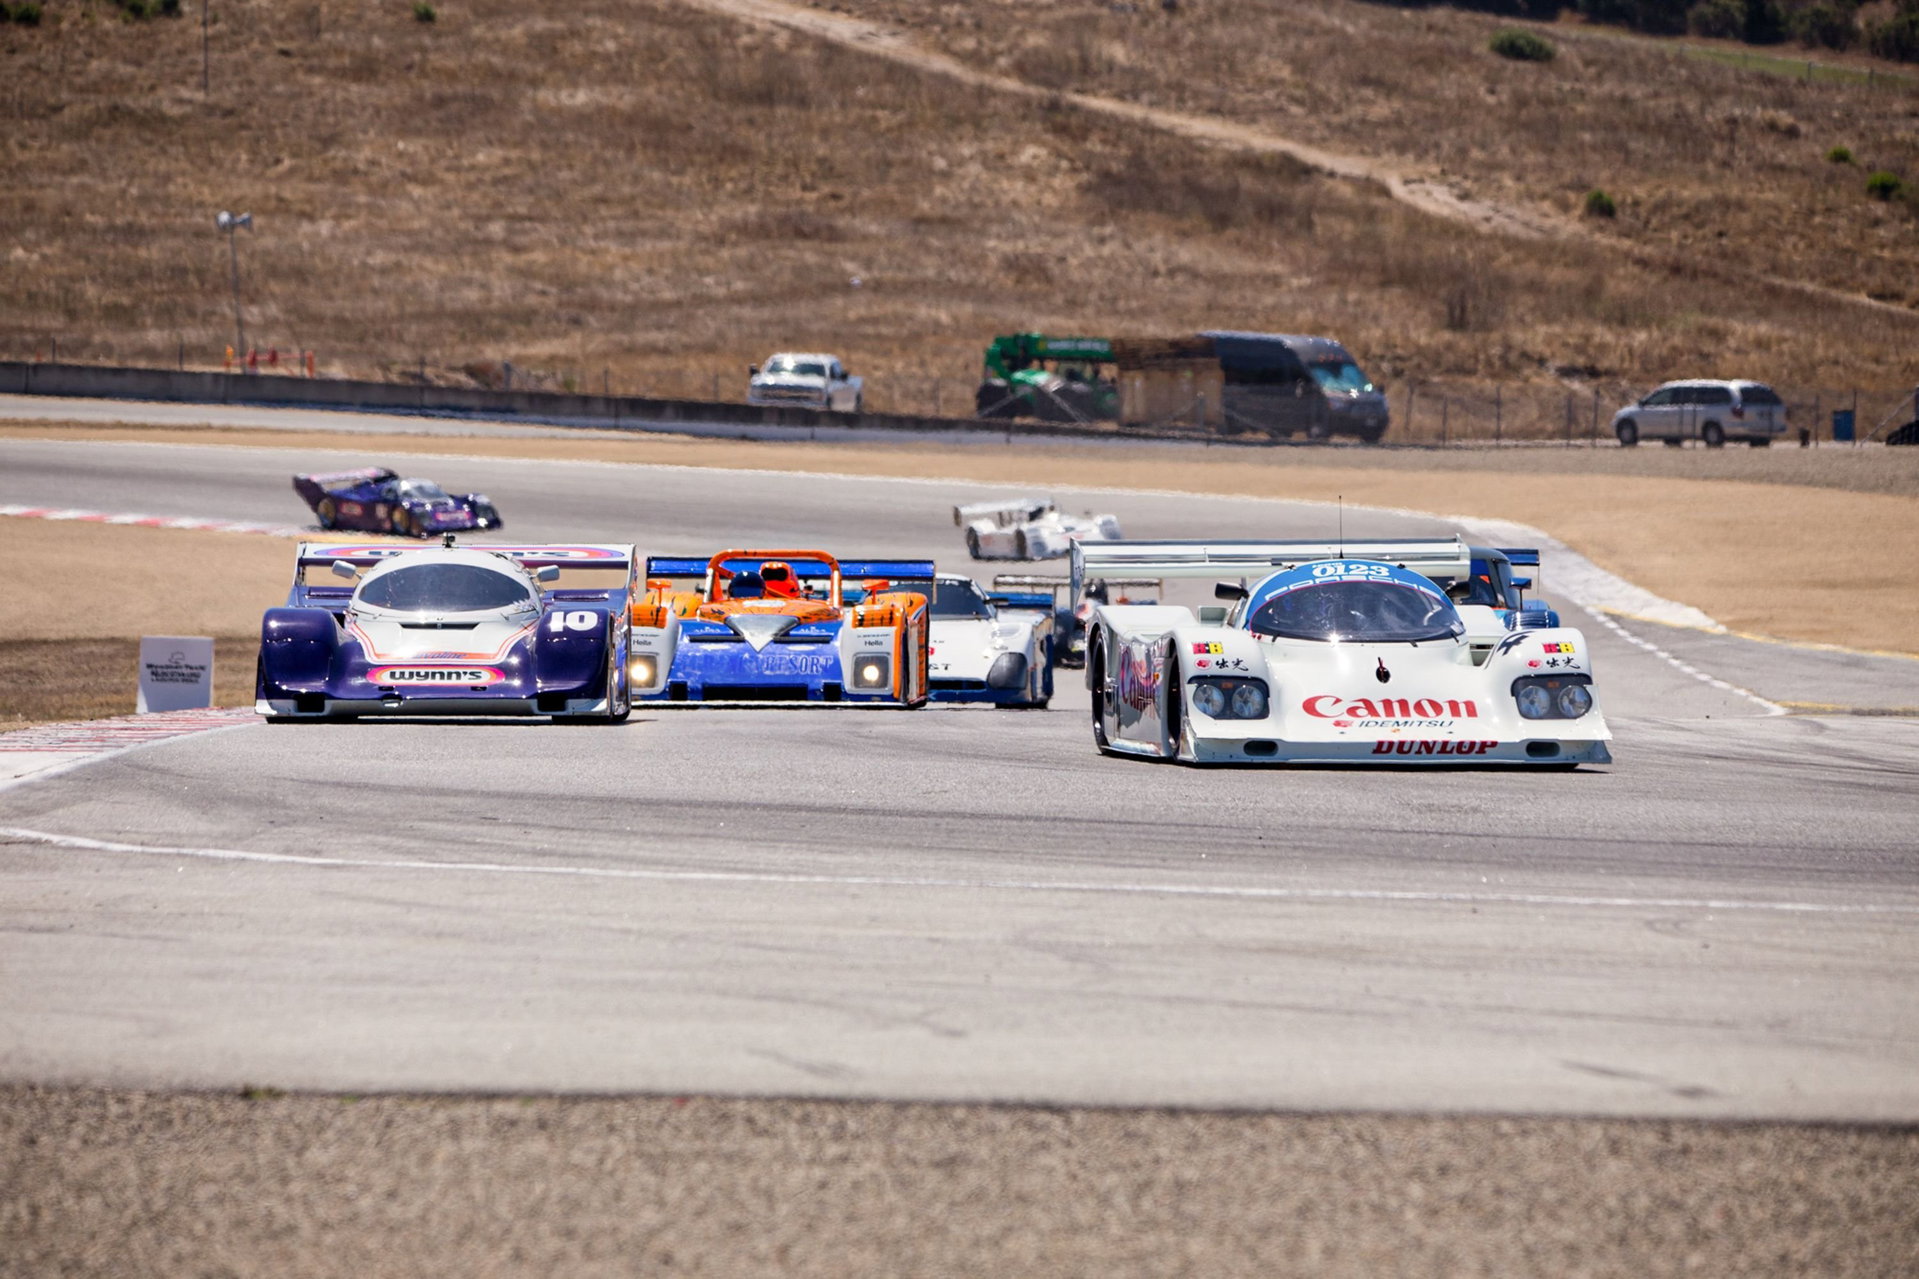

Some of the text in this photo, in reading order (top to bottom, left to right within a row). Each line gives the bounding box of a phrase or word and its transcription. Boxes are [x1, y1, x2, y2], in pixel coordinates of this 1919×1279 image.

[1312, 564, 1390, 577] 0123
[550, 611, 599, 633] 10
[864, 639, 884, 647] Hella
[388, 671, 482, 681] wynn's
[1302, 695, 1478, 718] Canon
[1358, 719, 1454, 728] IDEMITSU
[1371, 740, 1499, 755] DUNLOP
